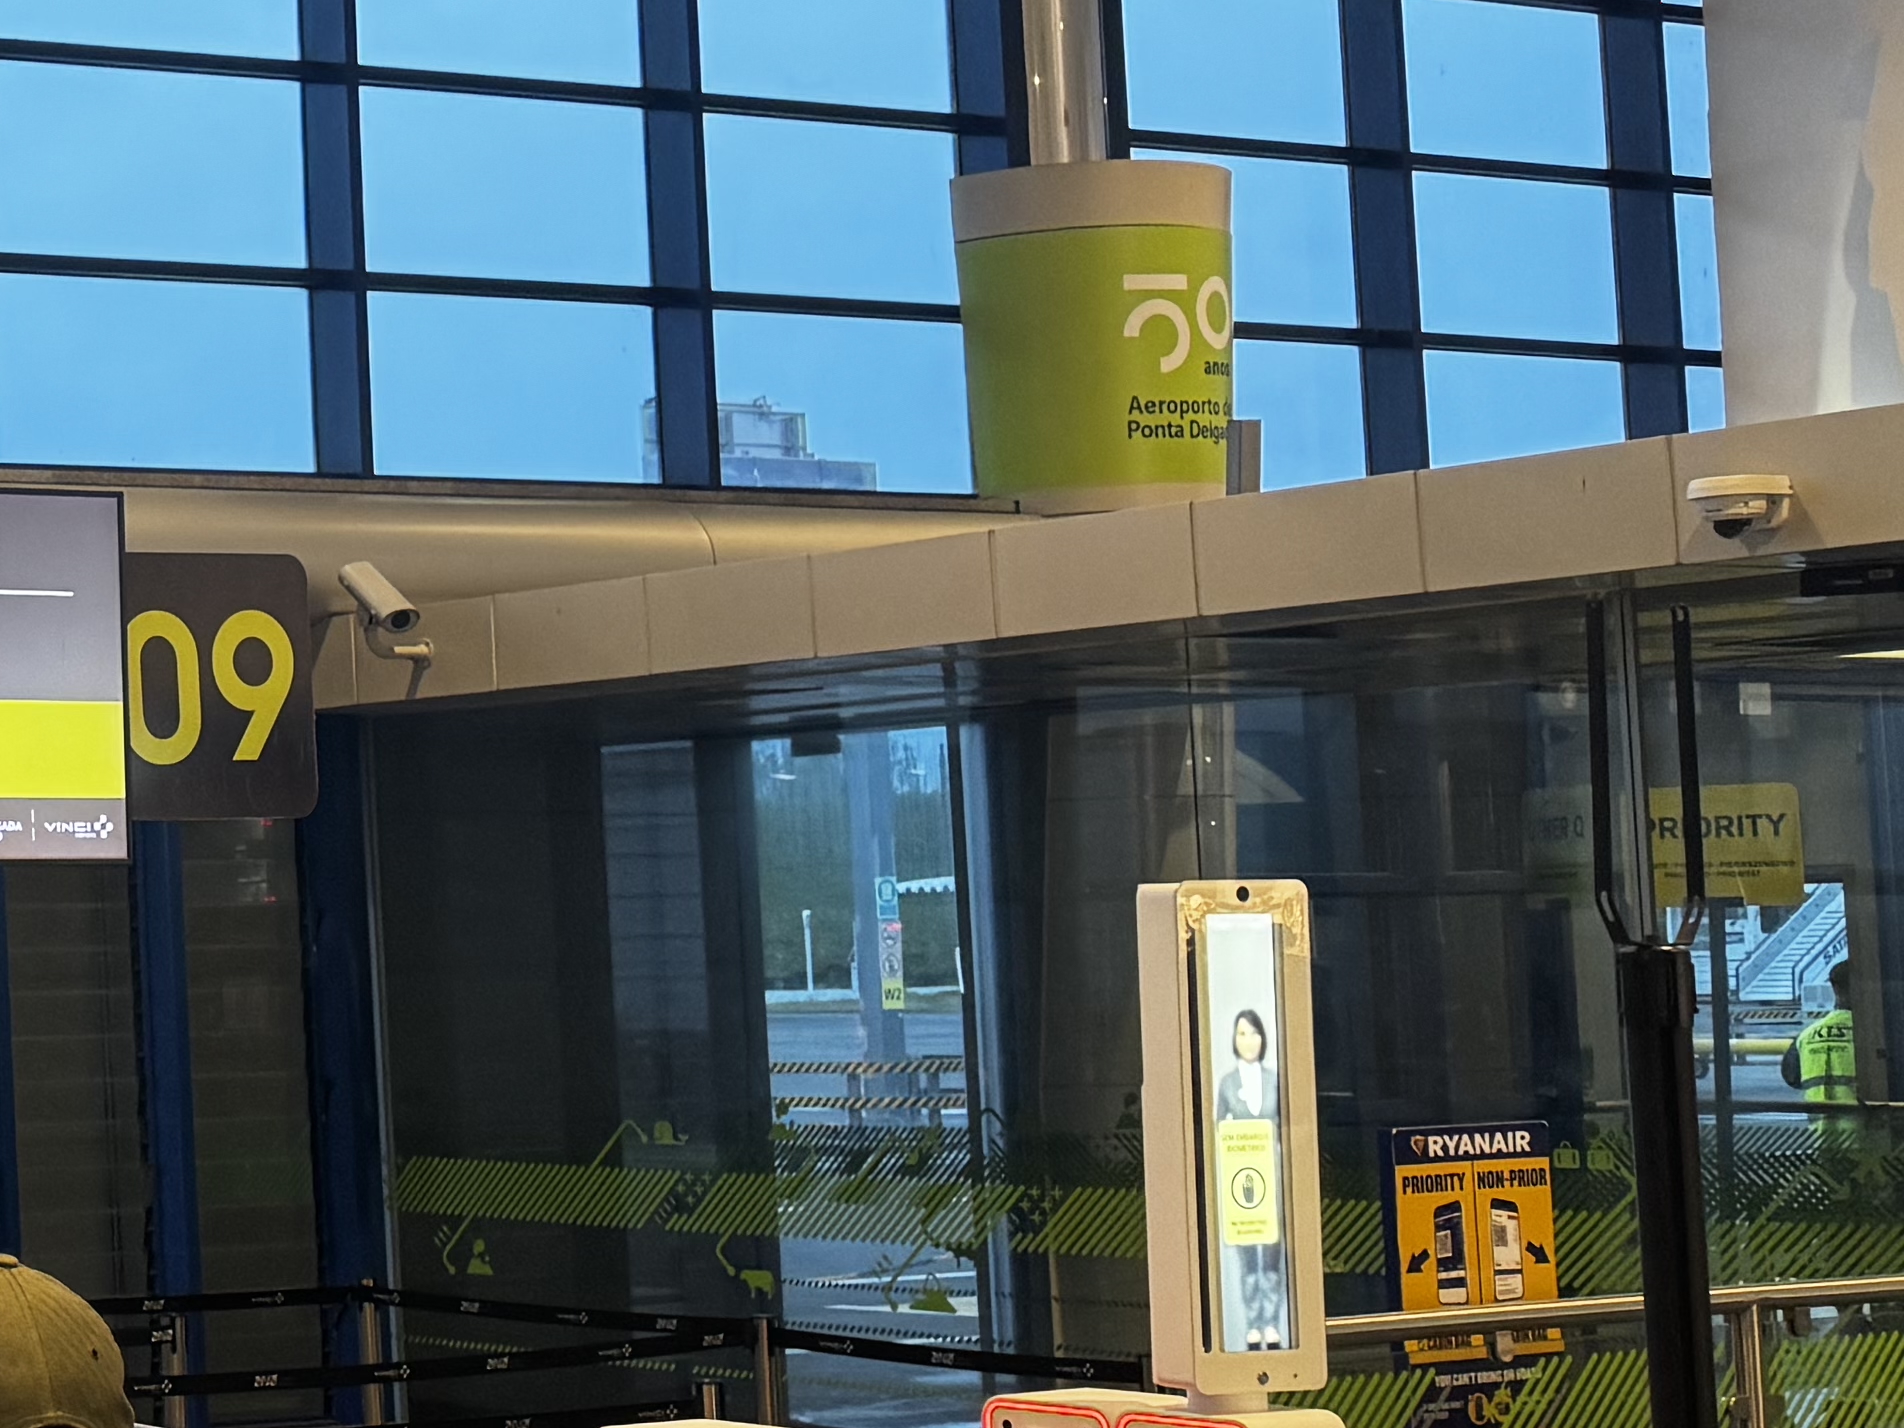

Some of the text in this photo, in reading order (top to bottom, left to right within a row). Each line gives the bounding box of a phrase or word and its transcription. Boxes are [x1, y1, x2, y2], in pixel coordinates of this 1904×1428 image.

[1128, 395, 1220, 420] Aeroporto
[1127, 419, 1184, 440] Ponta
[127, 609, 294, 766] 09
[44, 822, 92, 833] VINCI
[1427, 1130, 1532, 1158] RYANAIR
[1402, 1172, 1466, 1195] PRIORITY
[1476, 1168, 1548, 1190] NON-PRIOR
